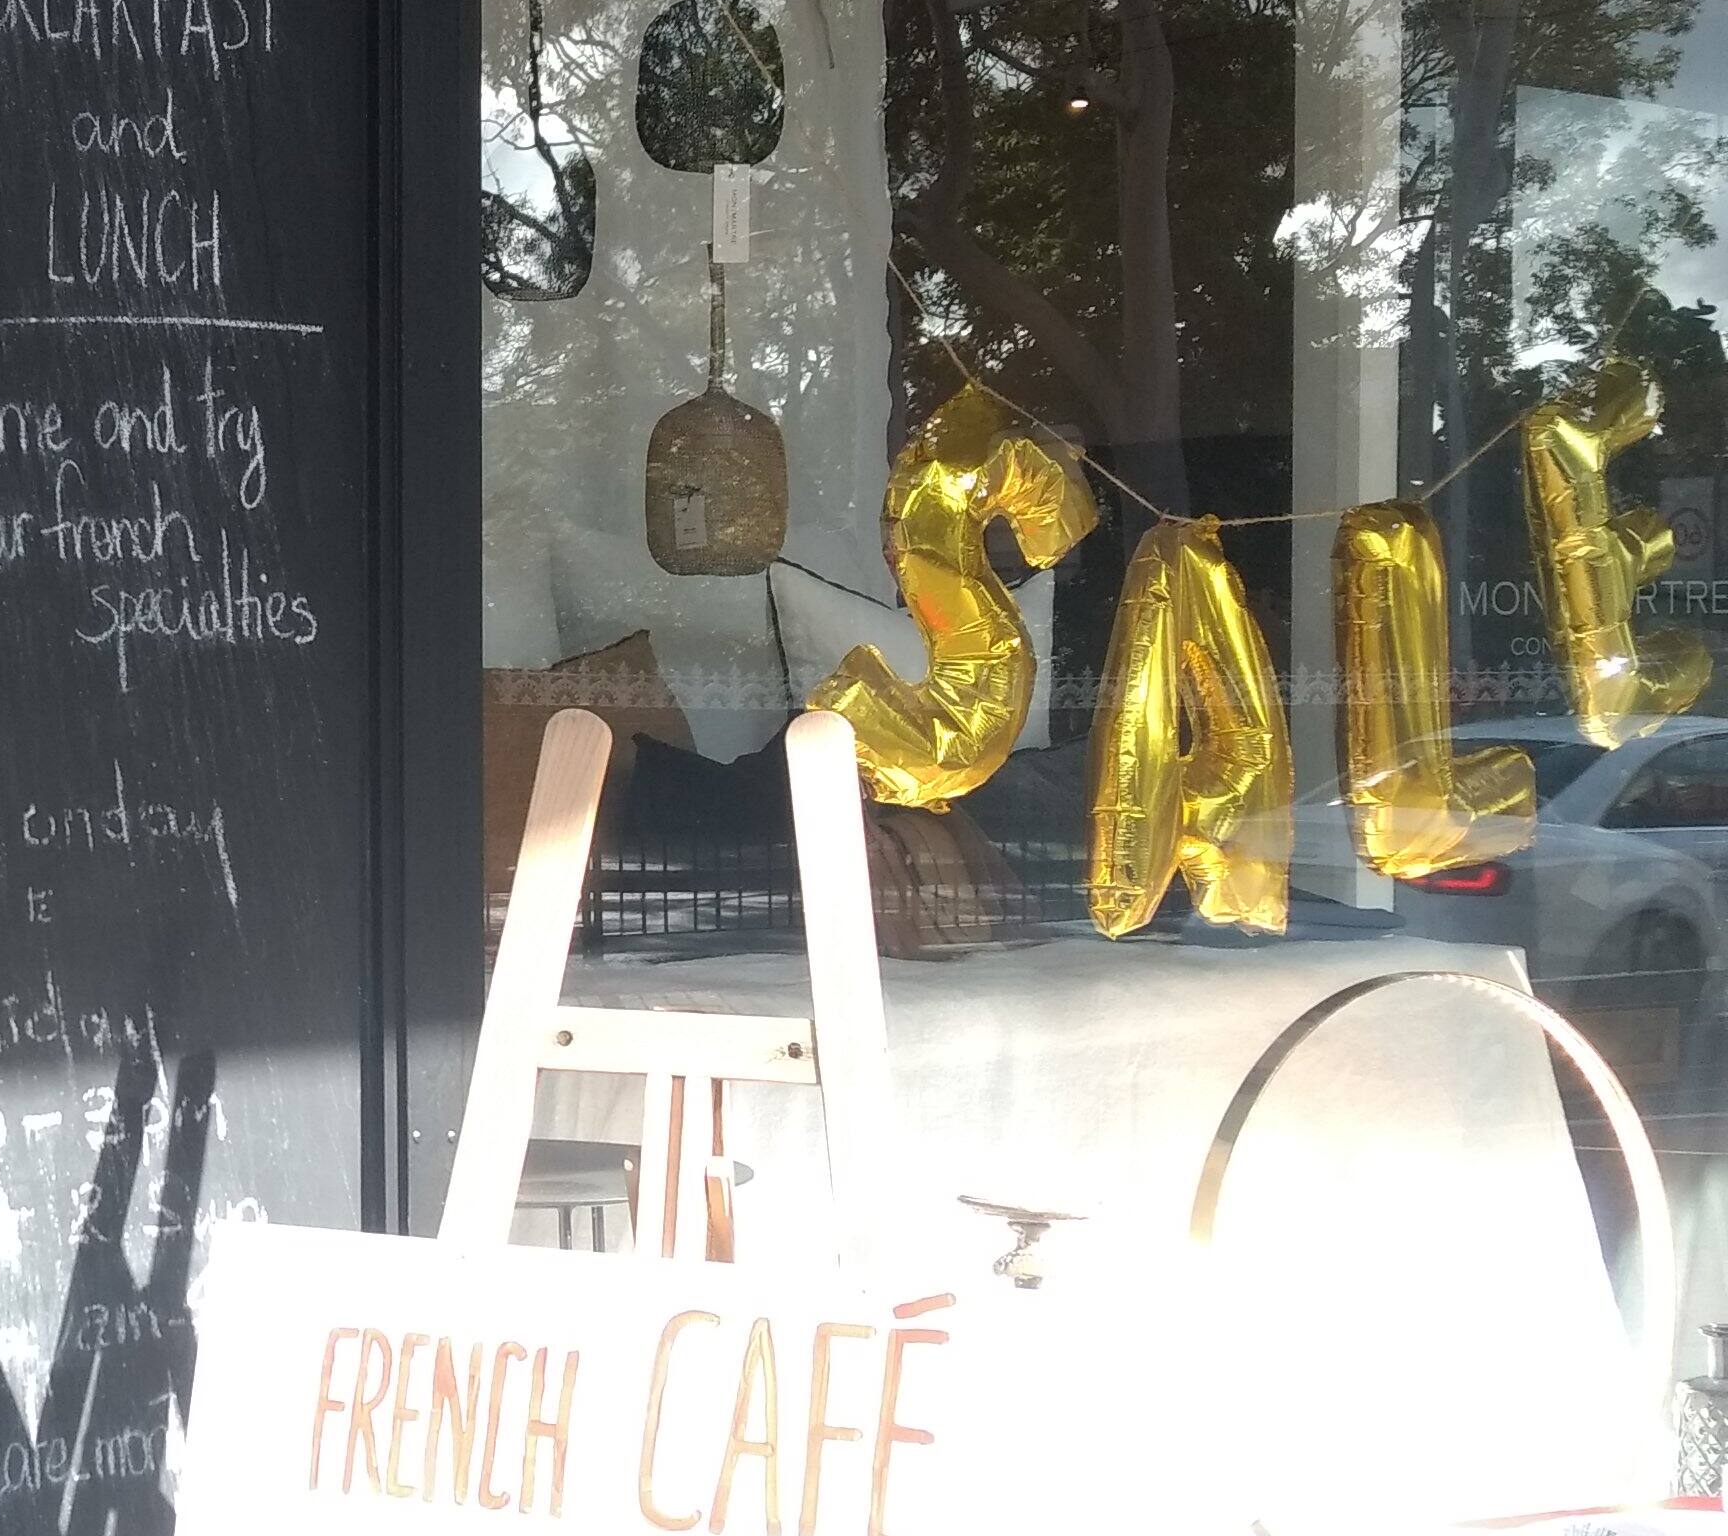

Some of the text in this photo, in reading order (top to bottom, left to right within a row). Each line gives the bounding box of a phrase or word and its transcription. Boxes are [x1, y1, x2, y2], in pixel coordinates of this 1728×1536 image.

[71, 87, 188, 165] and
[46, 183, 222, 291] LUNCH
[94, 359, 188, 455] and
[197, 356, 267, 511] try
[75, 527, 319, 694] specialties
[309, 1326, 579, 1518] FRENCH
